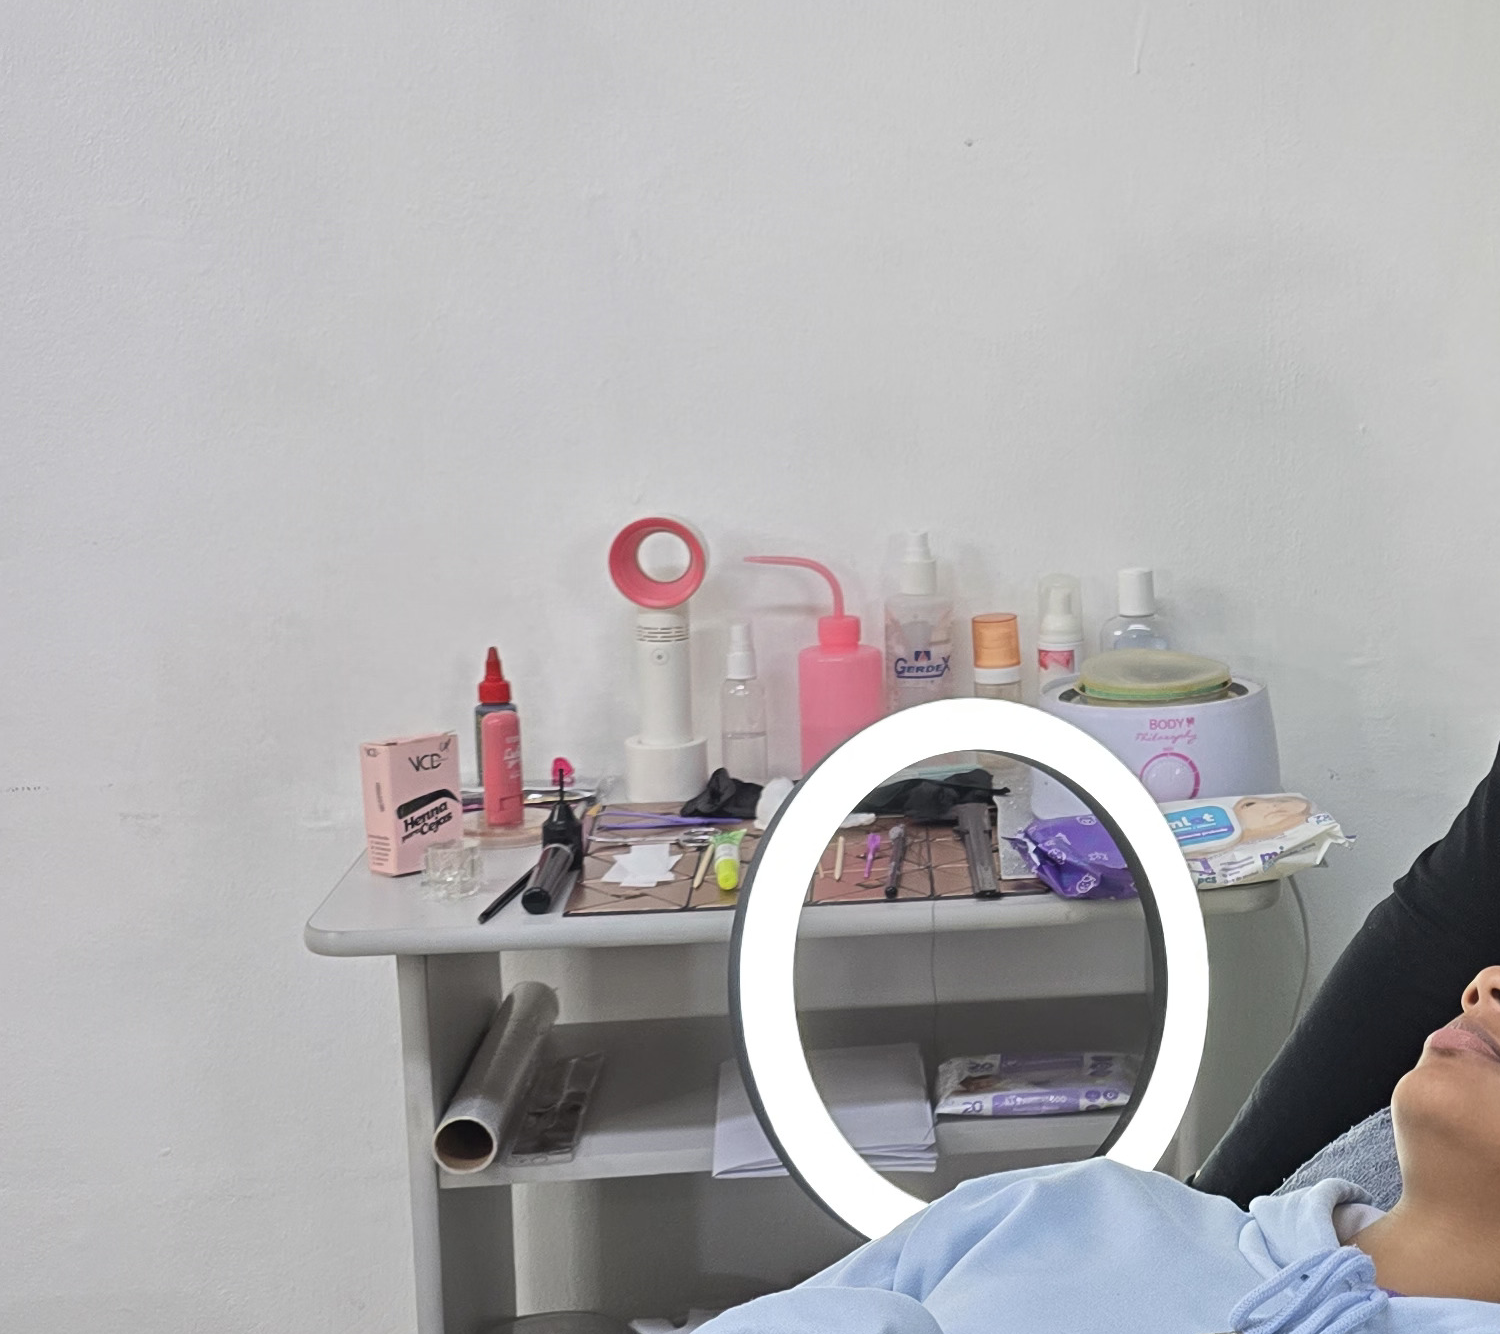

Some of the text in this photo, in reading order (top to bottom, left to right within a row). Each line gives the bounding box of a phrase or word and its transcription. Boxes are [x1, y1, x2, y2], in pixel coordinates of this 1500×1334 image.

[1149, 718, 1185, 731] BODY
[403, 801, 448, 833] Henna
[420, 811, 453, 836] Cejas
